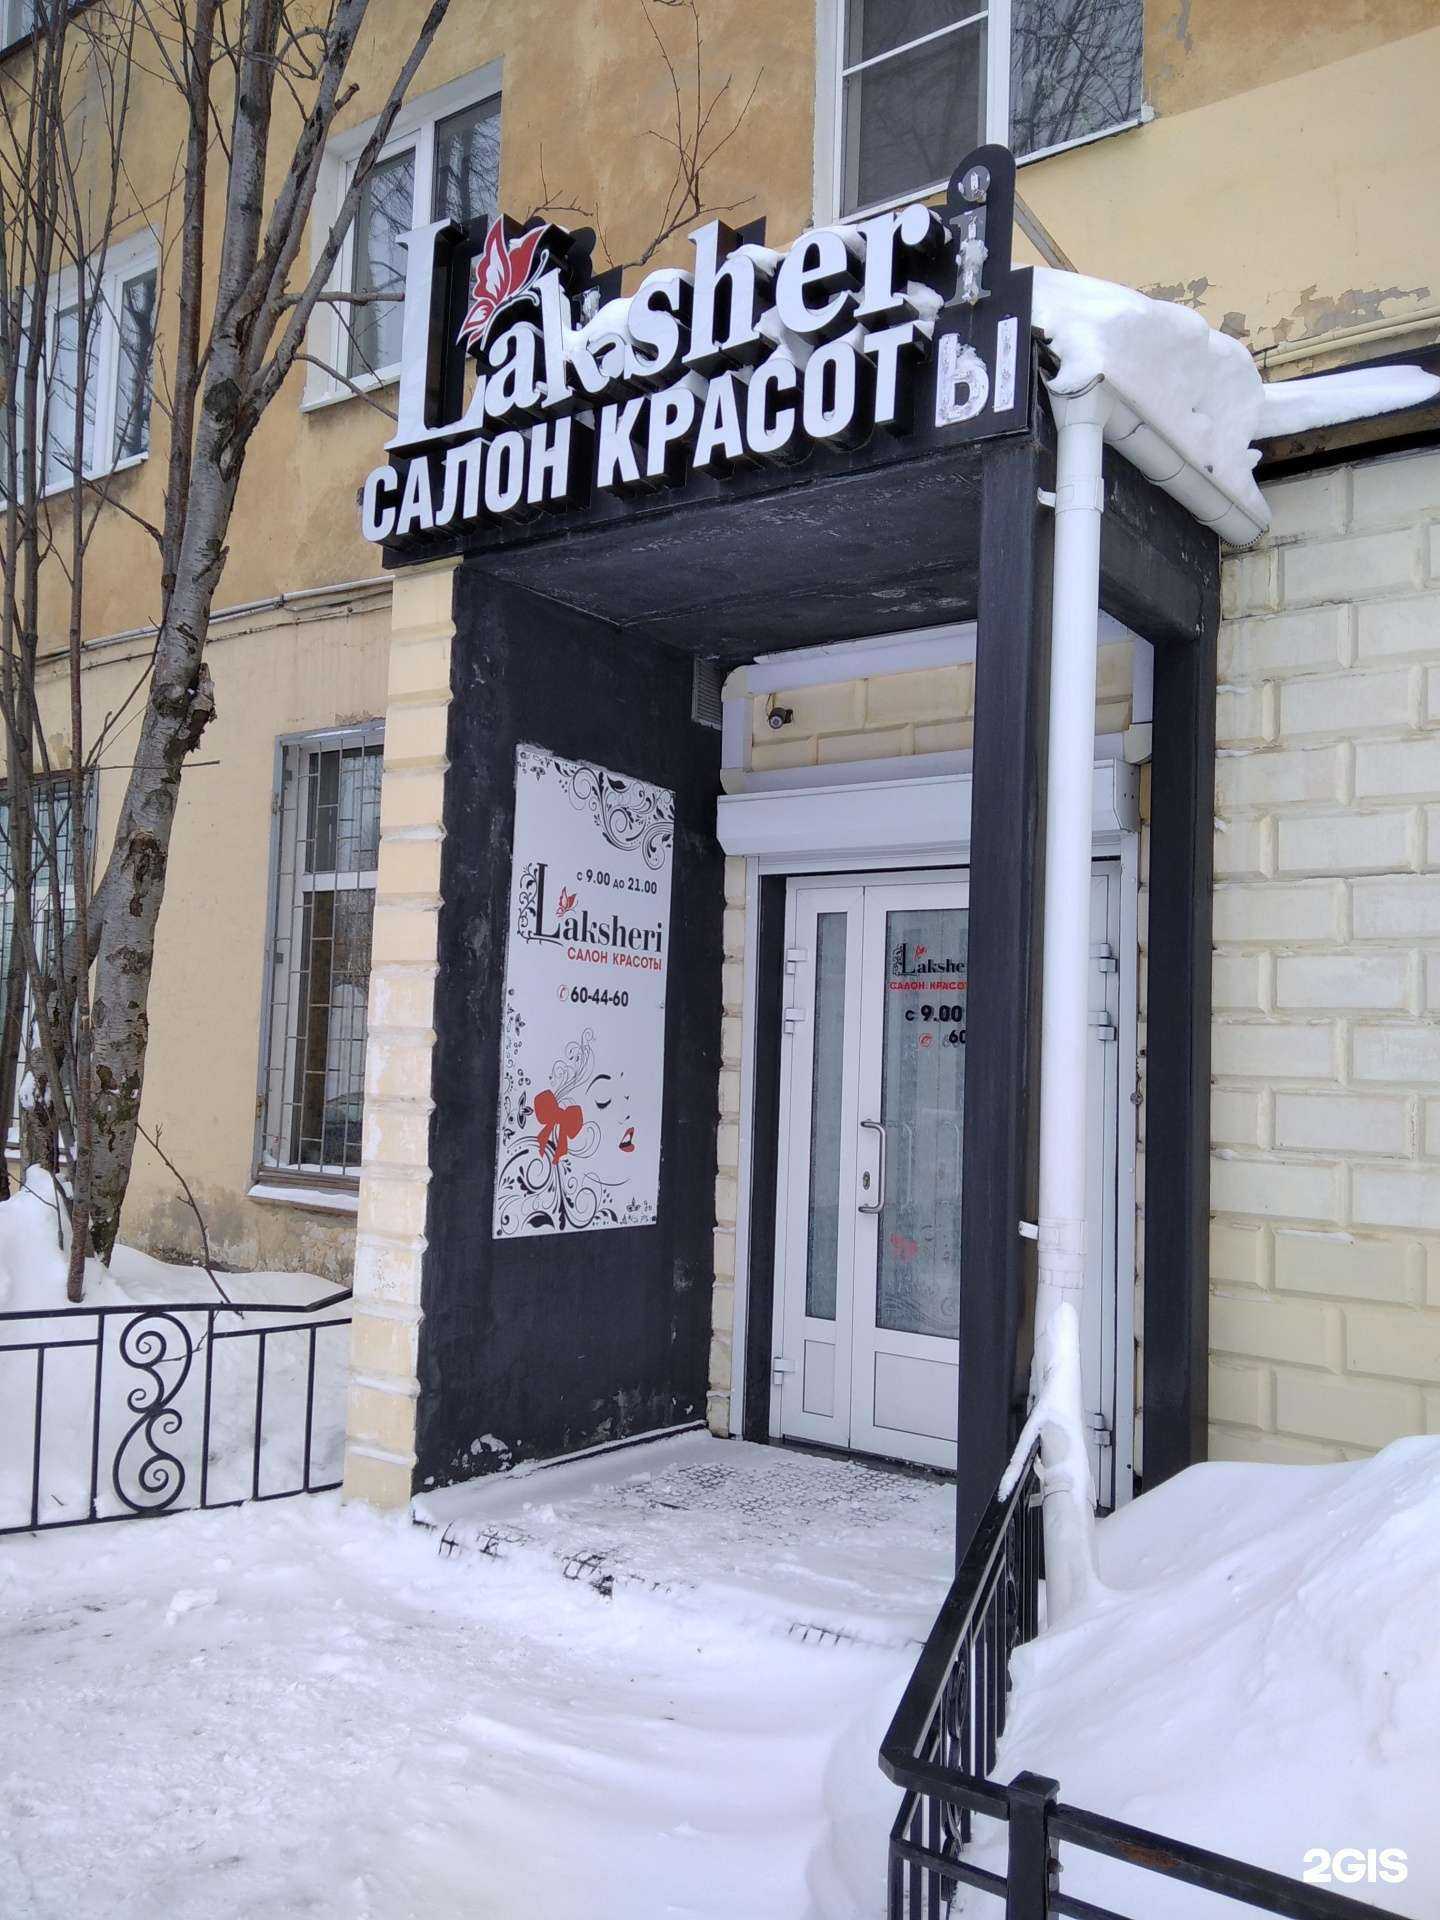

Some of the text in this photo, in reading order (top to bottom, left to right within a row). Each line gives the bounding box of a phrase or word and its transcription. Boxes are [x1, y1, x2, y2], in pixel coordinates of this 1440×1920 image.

[384, 163, 993, 452] Laksheri
[361, 315, 1018, 543] САЛОН КРАСОТЫ
[576, 868, 658, 895] с 9.00 до 21.00
[532, 862, 663, 953] Laksheri
[567, 946, 662, 971] САЛОН КРАСОТЫ
[570, 986, 629, 1007] 60-44-60
[889, 981, 968, 990] САЛОН КРАСО
[905, 1004, 962, 1022] с 9.00
